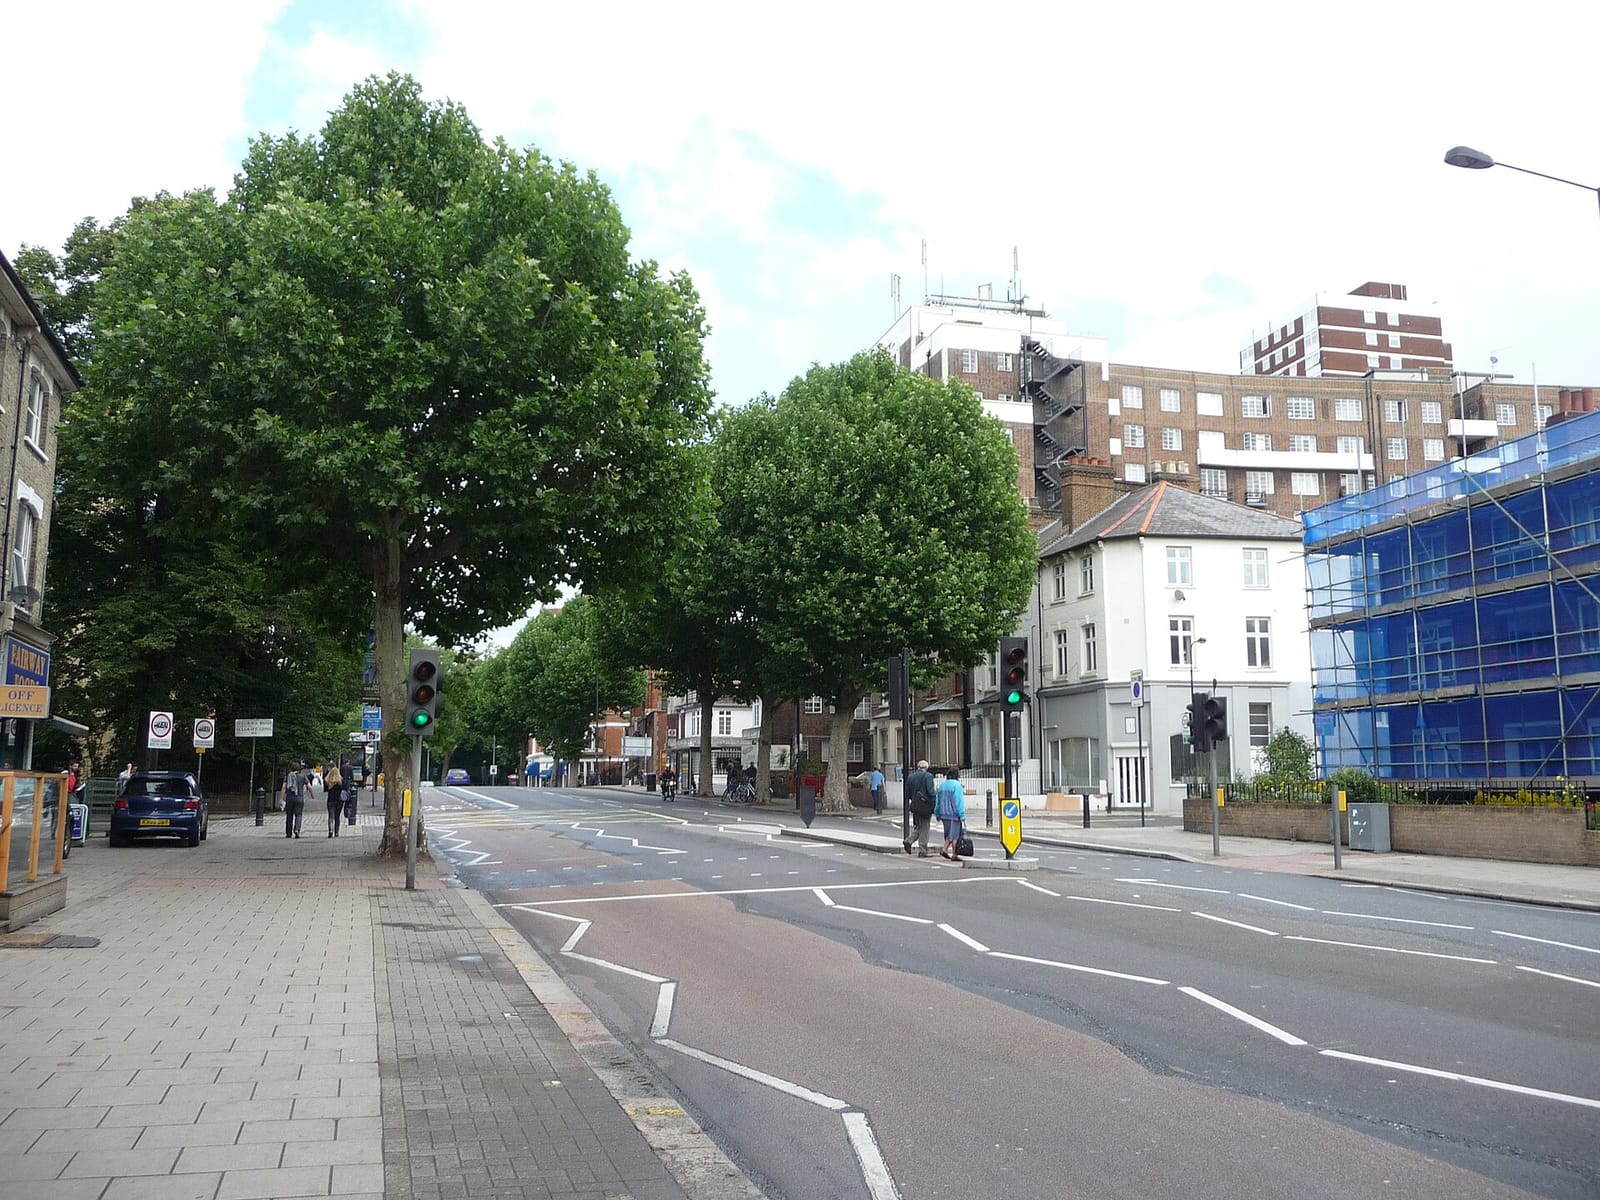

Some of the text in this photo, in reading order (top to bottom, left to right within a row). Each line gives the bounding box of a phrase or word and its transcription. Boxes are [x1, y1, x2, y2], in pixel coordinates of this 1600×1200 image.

[10, 643, 46, 676] FAIRWAY
[8, 690, 34, 700] OFF
[0, 703, 42, 713] LICENCE
